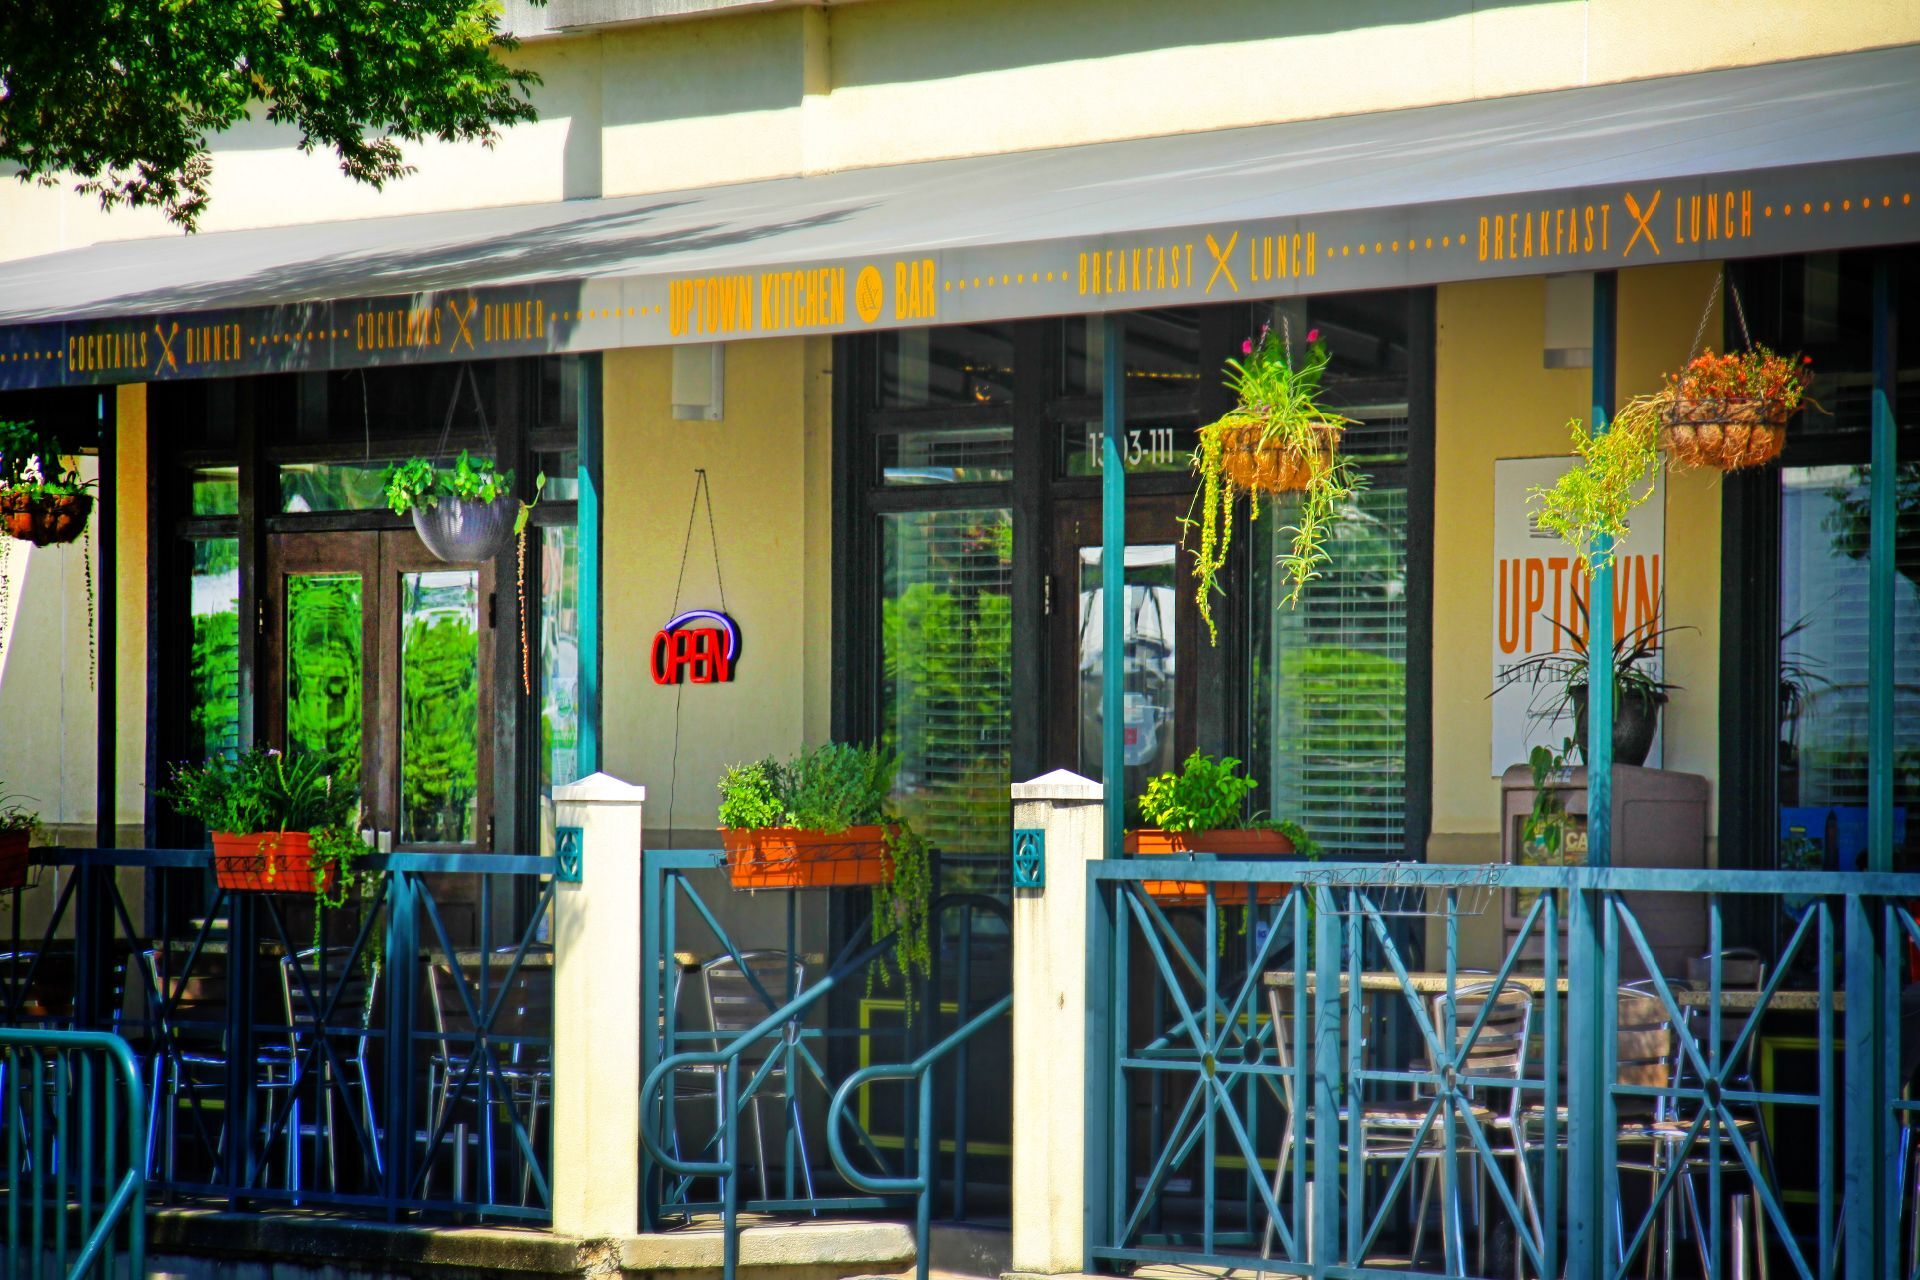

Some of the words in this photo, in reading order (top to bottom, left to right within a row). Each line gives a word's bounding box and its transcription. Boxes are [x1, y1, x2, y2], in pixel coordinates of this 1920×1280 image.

[1478, 203, 1611, 262] BREAKFAST
[1675, 190, 1752, 244] LUNCH
[1078, 243, 1193, 296] BREAKFAST
[1251, 231, 1316, 282] LUNCH
[357, 307, 441, 351] COCKTAILS
[484, 299, 544, 342] DINNER
[669, 274, 753, 337] UPTOWN
[760, 266, 845, 331] KITCHEN
[895, 258, 936, 320] BAR
[69, 331, 147, 371] COCKTAILS
[187, 324, 241, 364] DINNER
[1089, 428, 1173, 467] 13-111
[651, 628, 729, 685] OPEN
